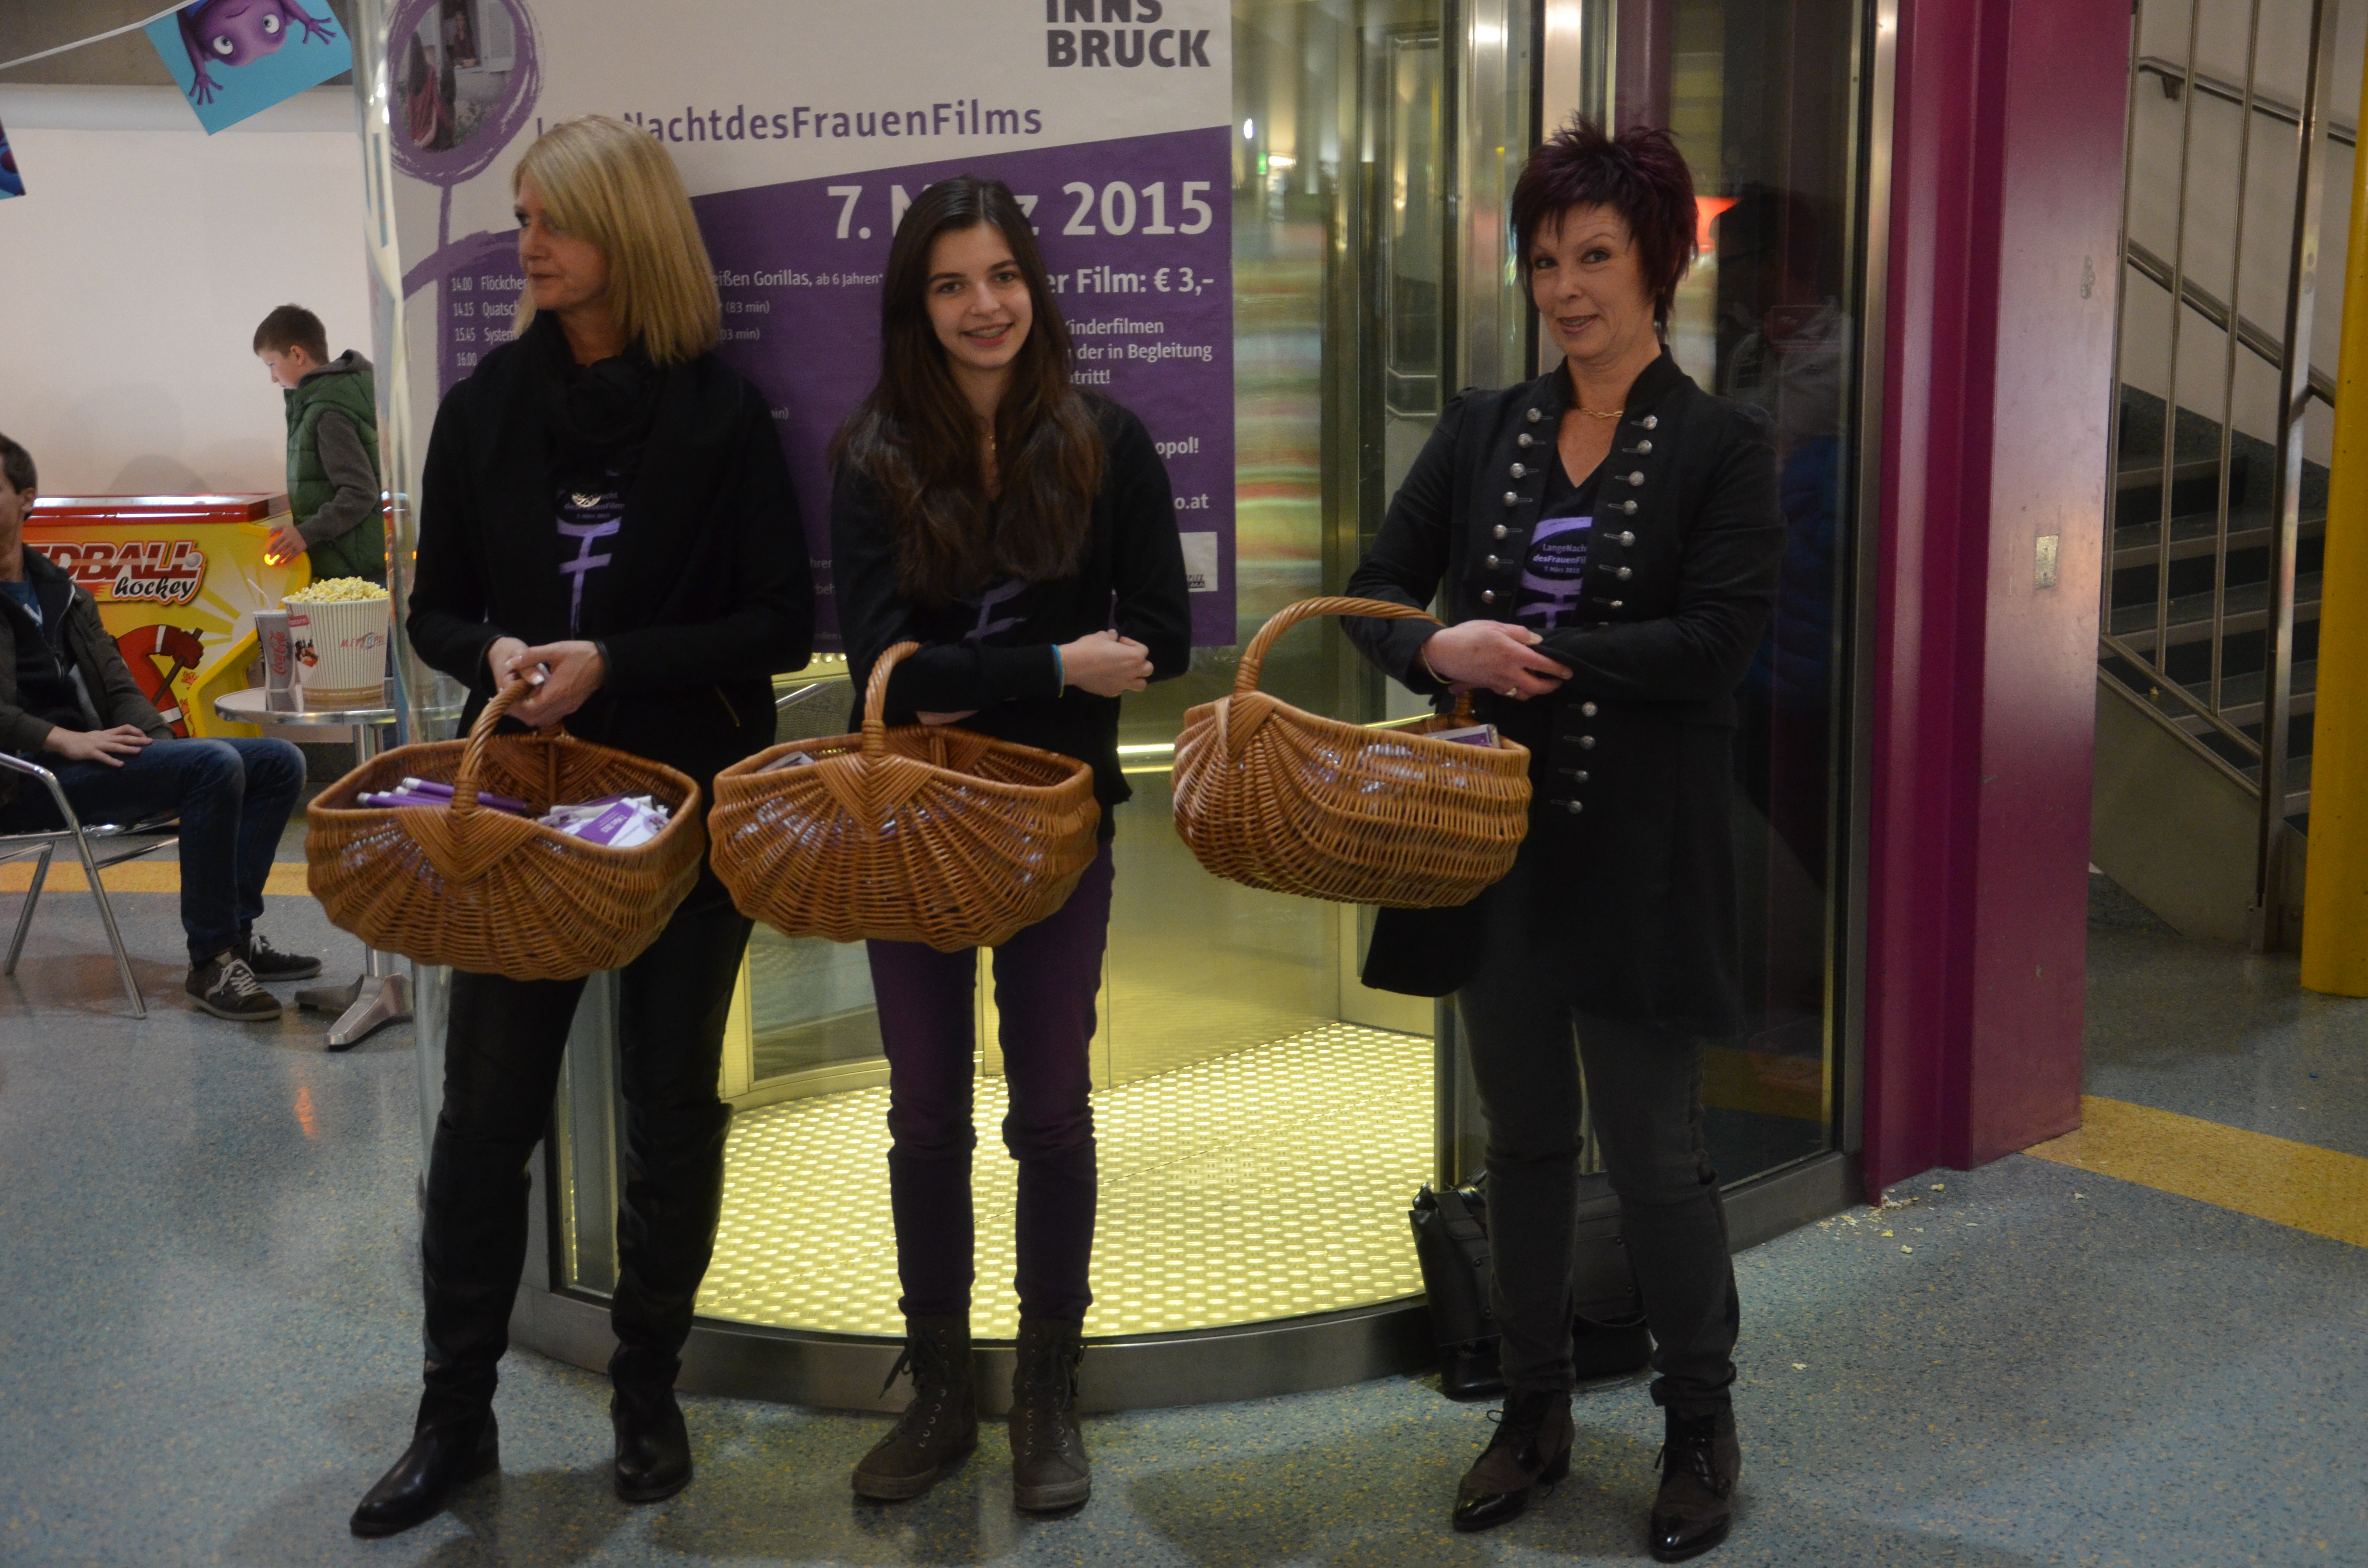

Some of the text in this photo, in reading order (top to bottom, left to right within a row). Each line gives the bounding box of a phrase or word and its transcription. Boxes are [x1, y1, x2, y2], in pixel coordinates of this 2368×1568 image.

[1047, 0, 1163, 23] INNS
[1047, 29, 1211, 68] BRUCK
[827, 185, 872, 239] 7.
[1062, 181, 1213, 235] 2015
[452, 277, 473, 291] 14.00
[714, 270, 750, 286] eißen
[754, 269, 813, 287] Gorillas,
[816, 272, 830, 285] ab
[832, 273, 840, 285] 6
[1077, 266, 1147, 294] Film:
[1154, 267, 1171, 292] €
[454, 303, 474, 317] 14.15
[745, 300, 770, 314] min)
[456, 328, 476, 342] 15.45
[736, 327, 761, 342] min)
[457, 352, 477, 367] 16.00
[1077, 343, 1104, 360] der
[1107, 343, 1123, 359] in
[1127, 342, 1213, 363] Begleitung
[1542, 543, 1587, 554] LangeNach
[114, 576, 196, 599] hockey
